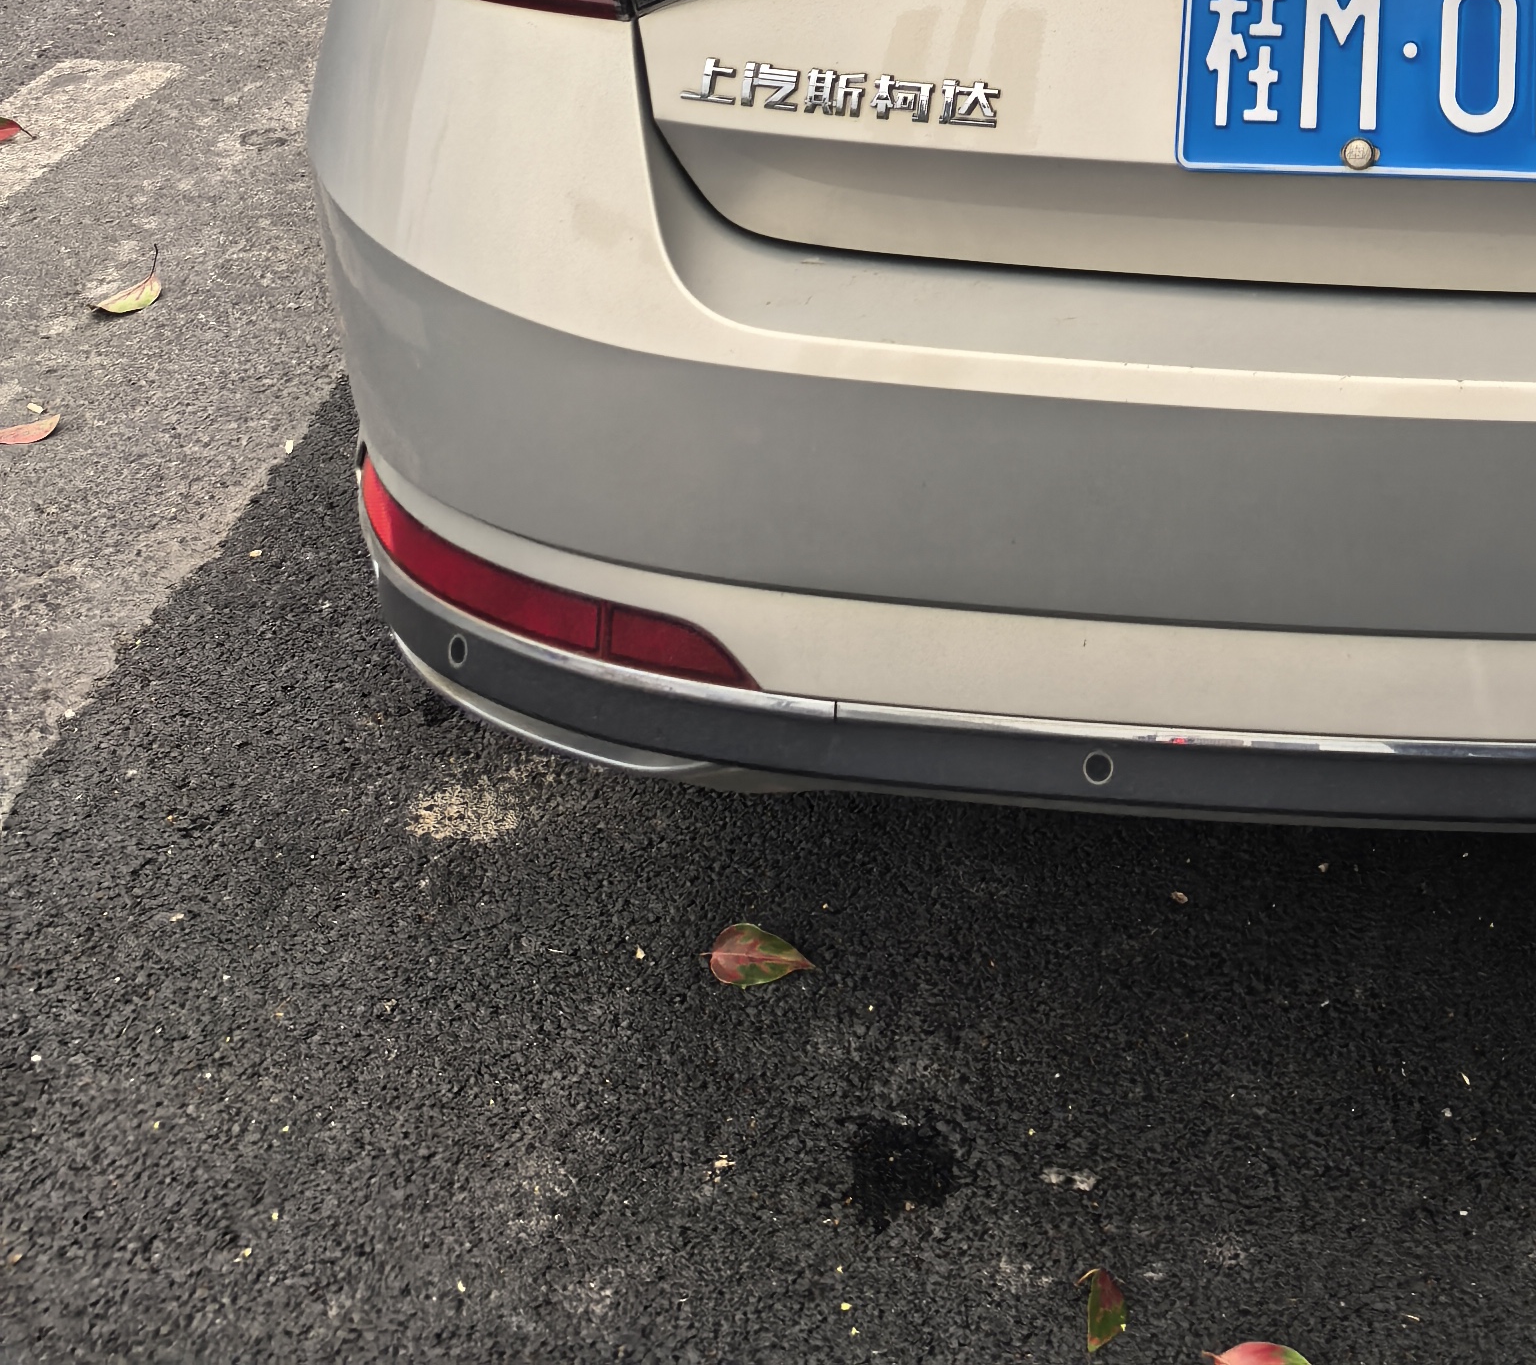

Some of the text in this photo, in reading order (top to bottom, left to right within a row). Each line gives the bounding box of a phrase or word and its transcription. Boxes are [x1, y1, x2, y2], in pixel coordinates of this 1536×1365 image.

[680, 57, 1001, 128] 上汽斯柯达
